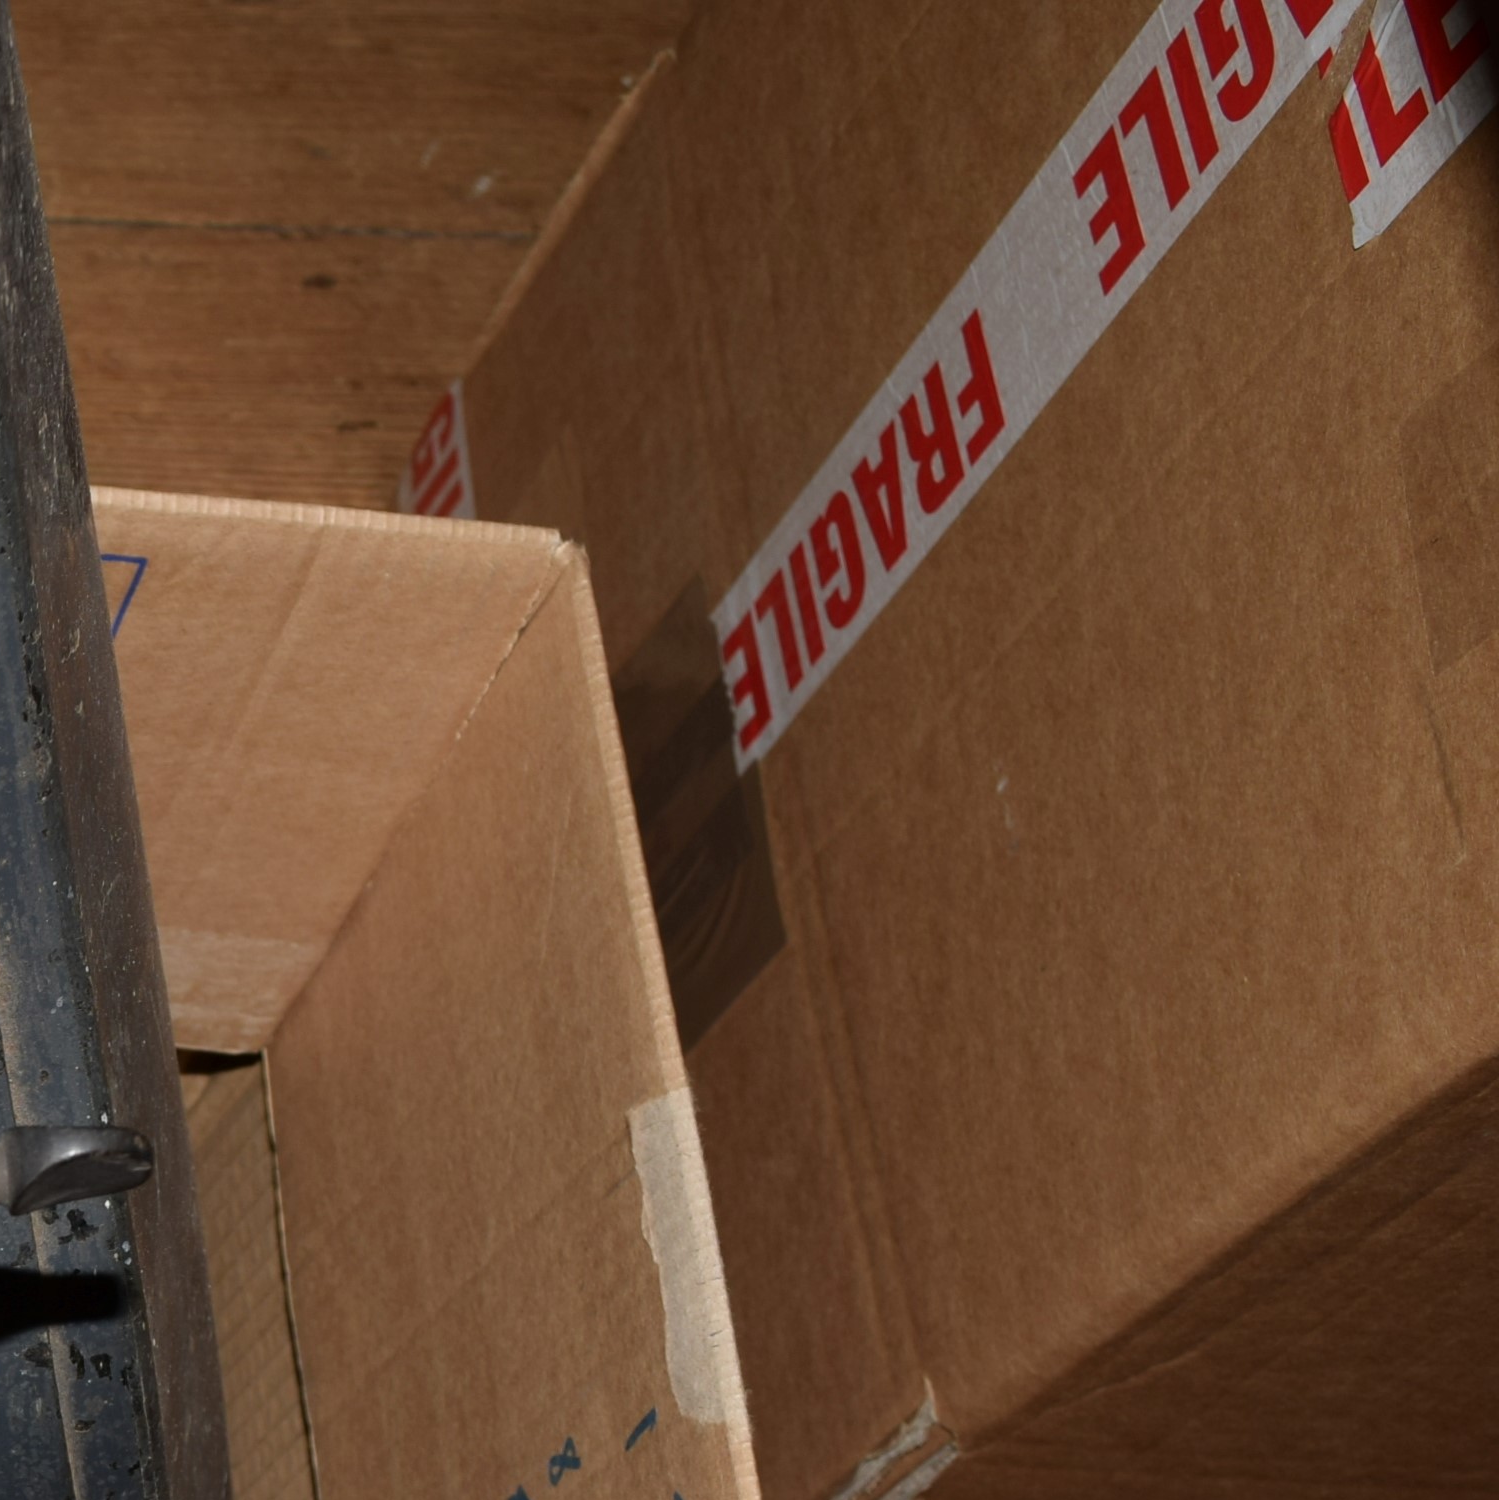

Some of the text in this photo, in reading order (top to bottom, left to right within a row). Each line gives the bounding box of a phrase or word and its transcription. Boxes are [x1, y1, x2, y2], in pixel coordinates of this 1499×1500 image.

[1072, 0, 1334, 297] GILE
[721, 308, 1006, 754] FRAGILE
[548, 1436, 582, 1486] 8
